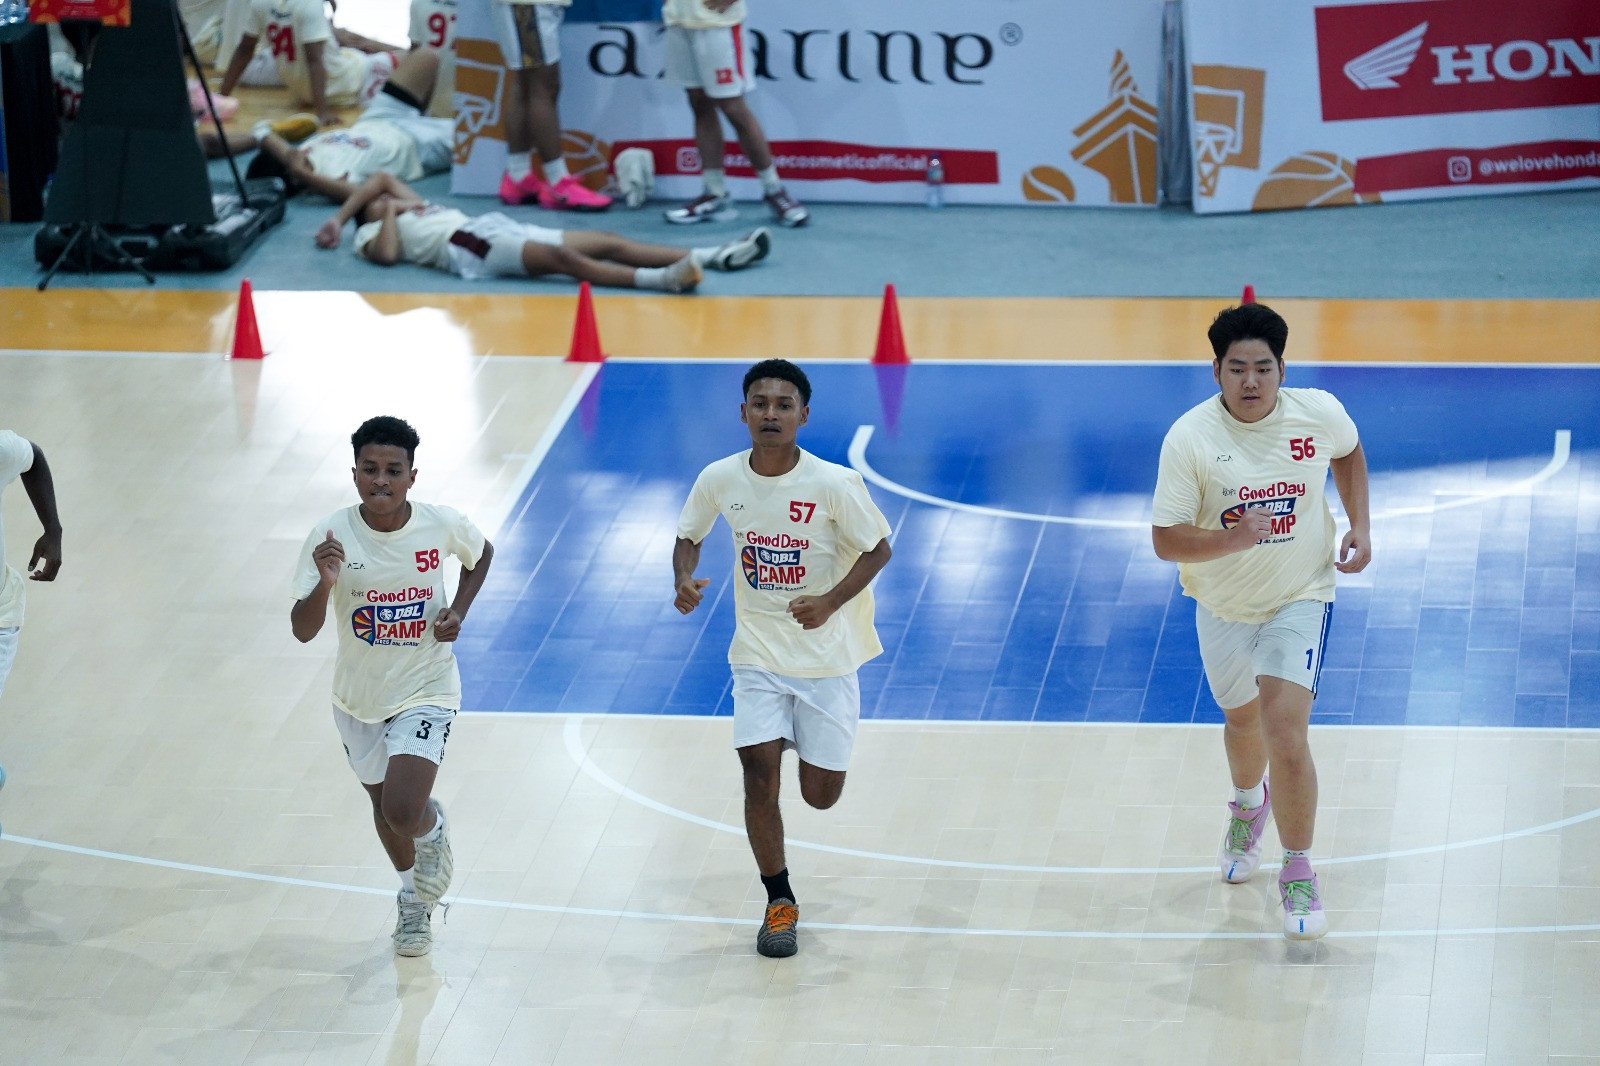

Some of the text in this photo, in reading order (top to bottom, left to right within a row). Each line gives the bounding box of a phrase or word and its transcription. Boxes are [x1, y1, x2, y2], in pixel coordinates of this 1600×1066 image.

[1289, 437, 1316, 461] 56
[1238, 484, 1275, 501] Good
[1277, 481, 1306, 497] Day
[789, 500, 817, 524] 57
[1270, 514, 1297, 535] MP
[746, 531, 780, 548] Good
[781, 533, 810, 550] Day
[415, 548, 440, 573] 58
[771, 552, 798, 564] DBL
[759, 565, 806, 585] CAMP
[366, 588, 406, 603] Good
[408, 585, 433, 600] Day
[393, 605, 422, 620] DBL
[376, 619, 427, 640] CAMP
[1305, 648, 1314, 671] 1
[416, 719, 433, 740] 3
